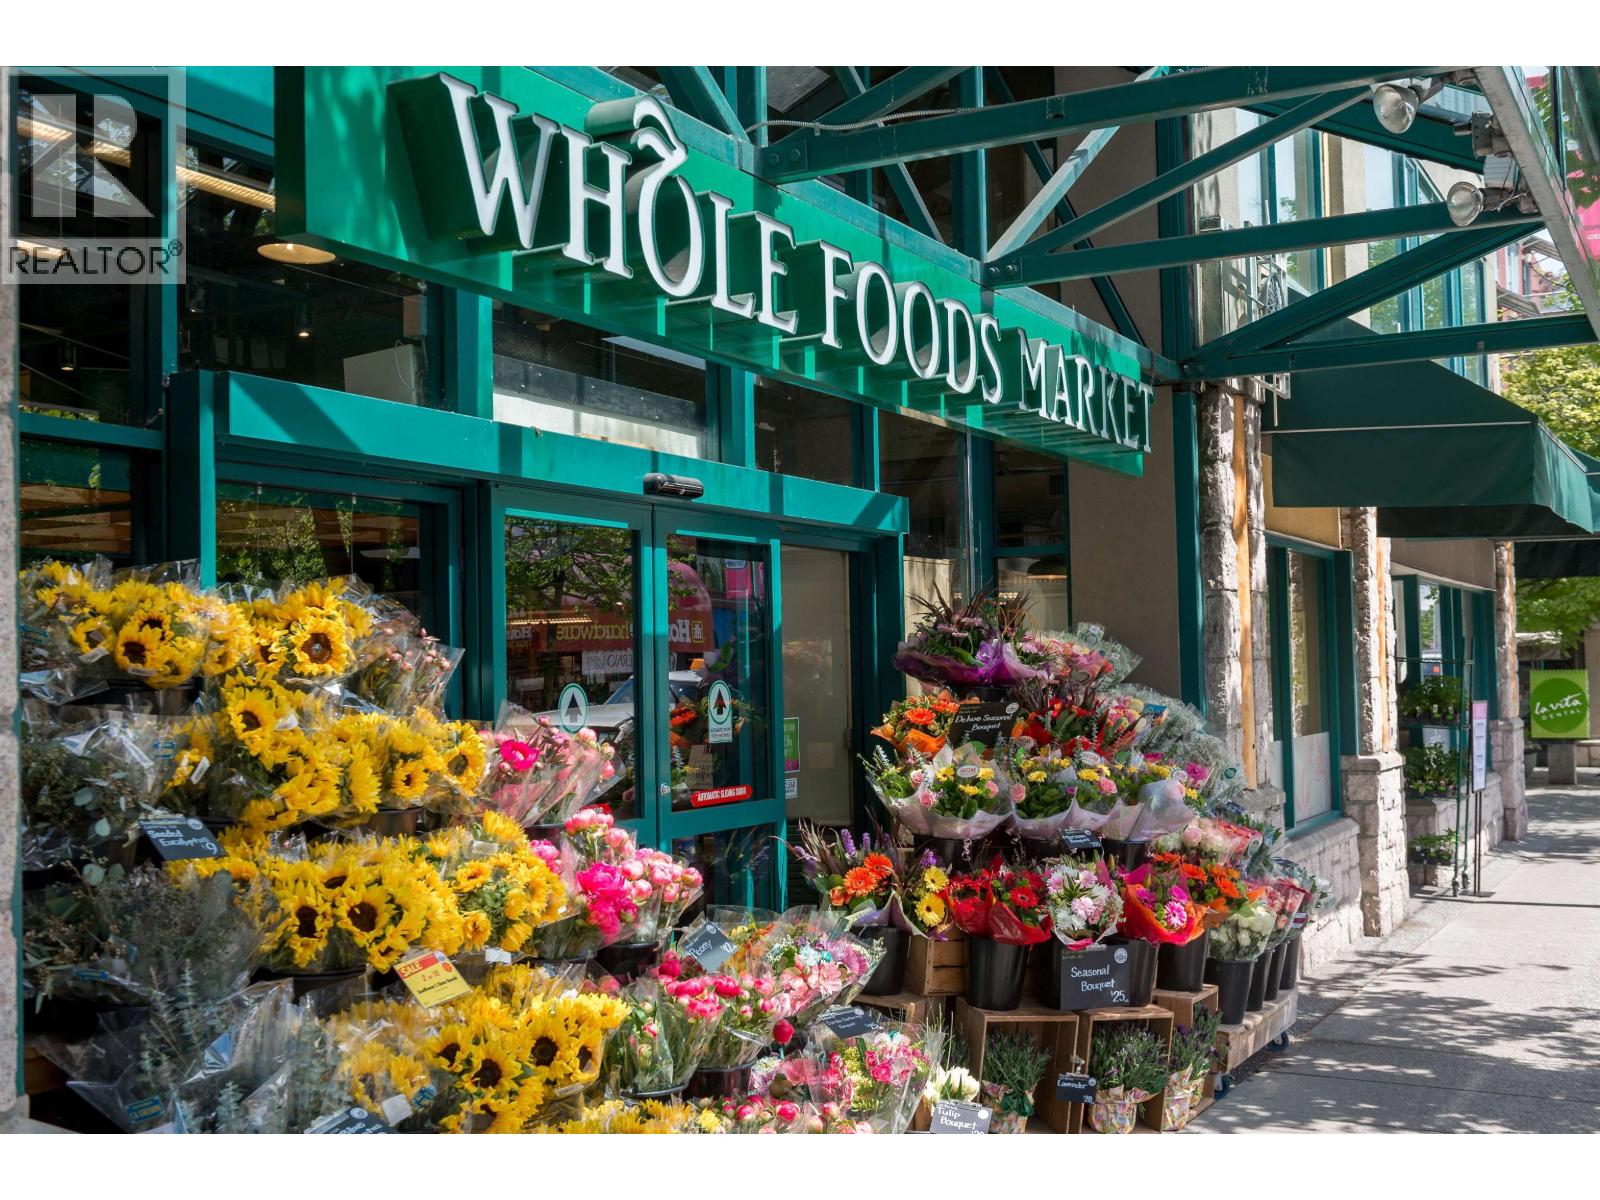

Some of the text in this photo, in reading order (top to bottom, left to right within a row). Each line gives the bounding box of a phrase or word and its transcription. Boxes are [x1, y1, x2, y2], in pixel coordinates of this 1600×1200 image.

[439, 71, 1155, 454] WHOLE FOODS MARKET
[1549, 692, 1582, 710] vita
[1541, 709, 1582, 721] DENTAL
[698, 790, 720, 802] AUTOMATIC
[720, 788, 736, 798] SLIDING
[687, 939, 713, 959] Peony
[400, 961, 422, 979] SALE
[1070, 963, 1110, 978] Seasonal
[1081, 978, 1116, 992] Bouquet
[1057, 1079, 1089, 1089] Lavender
[936, 1106, 961, 1119] Tulip
[940, 1116, 976, 1130] Bouquet
